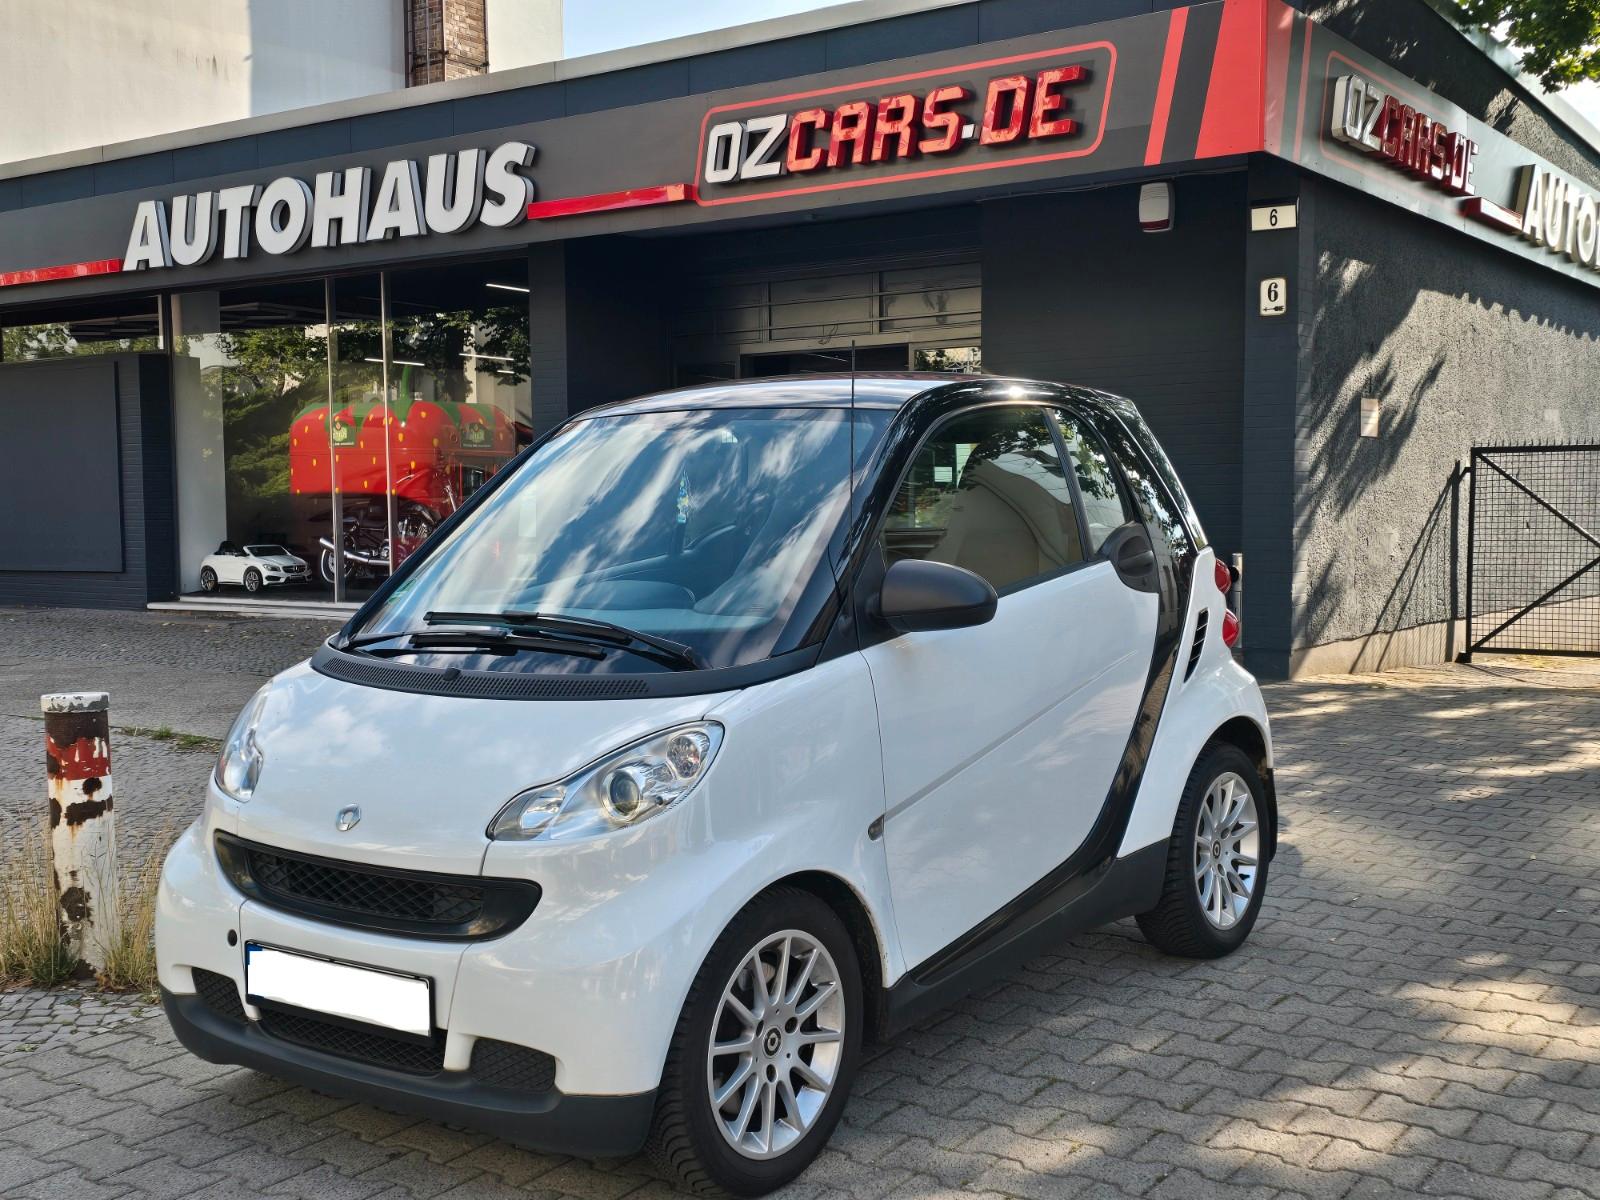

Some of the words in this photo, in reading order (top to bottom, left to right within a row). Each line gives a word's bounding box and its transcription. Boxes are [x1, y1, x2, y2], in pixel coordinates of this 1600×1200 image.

[704, 65, 1088, 183] OZCARS.DE
[1332, 74, 1479, 197] OZCARS.DE
[122, 141, 535, 272] AUTOHAUS
[1269, 208, 1278, 227] 6
[1516, 163, 1600, 273] AUTO
[1267, 281, 1279, 302] 6
